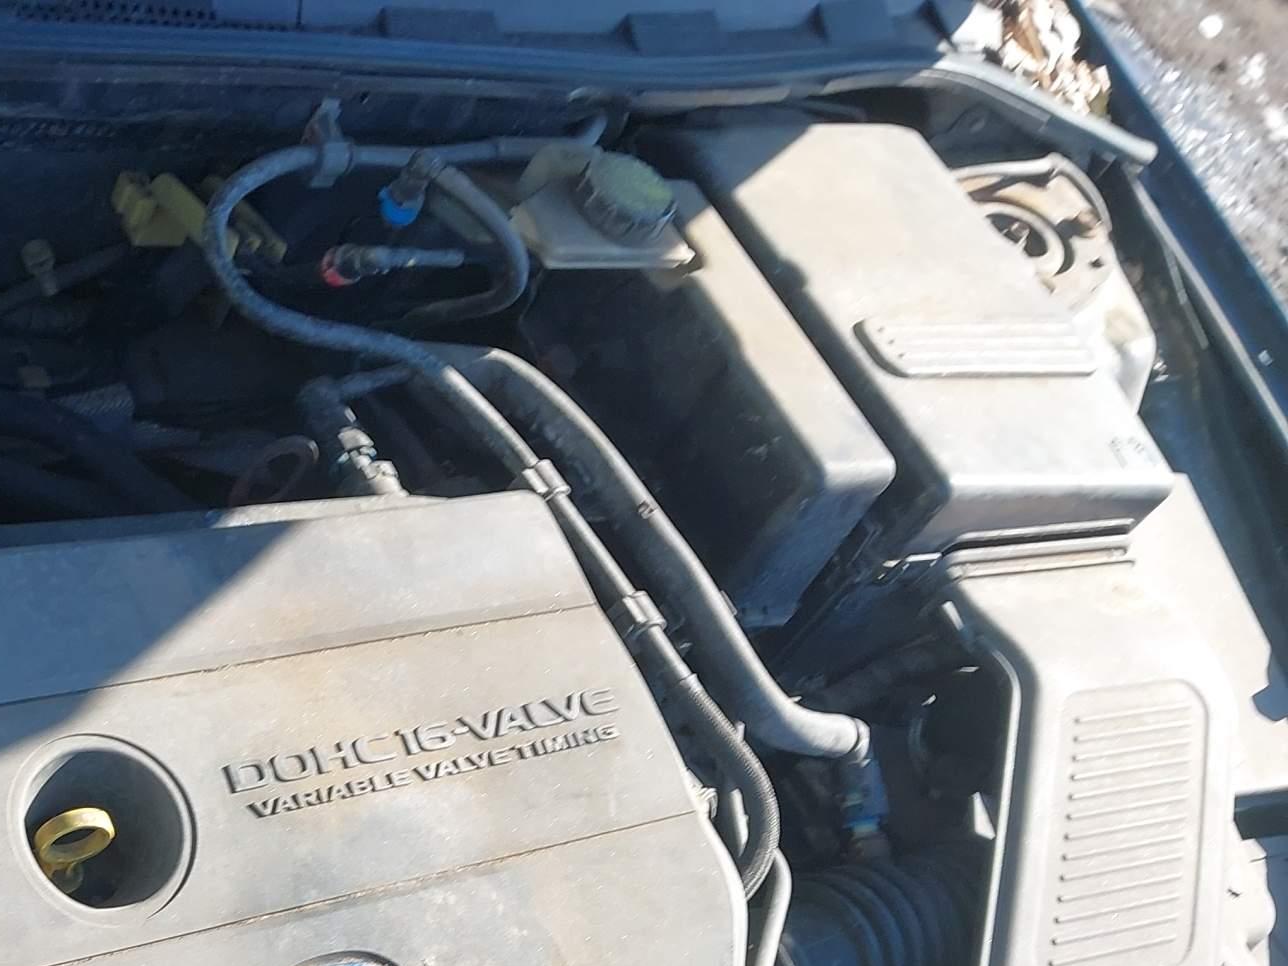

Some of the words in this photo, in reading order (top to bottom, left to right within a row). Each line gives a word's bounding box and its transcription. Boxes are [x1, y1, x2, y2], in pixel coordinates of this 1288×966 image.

[219, 733, 399, 795] DOHC
[245, 767, 412, 819] VARIABLE
[410, 748, 512, 782] VALVE
[508, 723, 622, 761] TIMING
